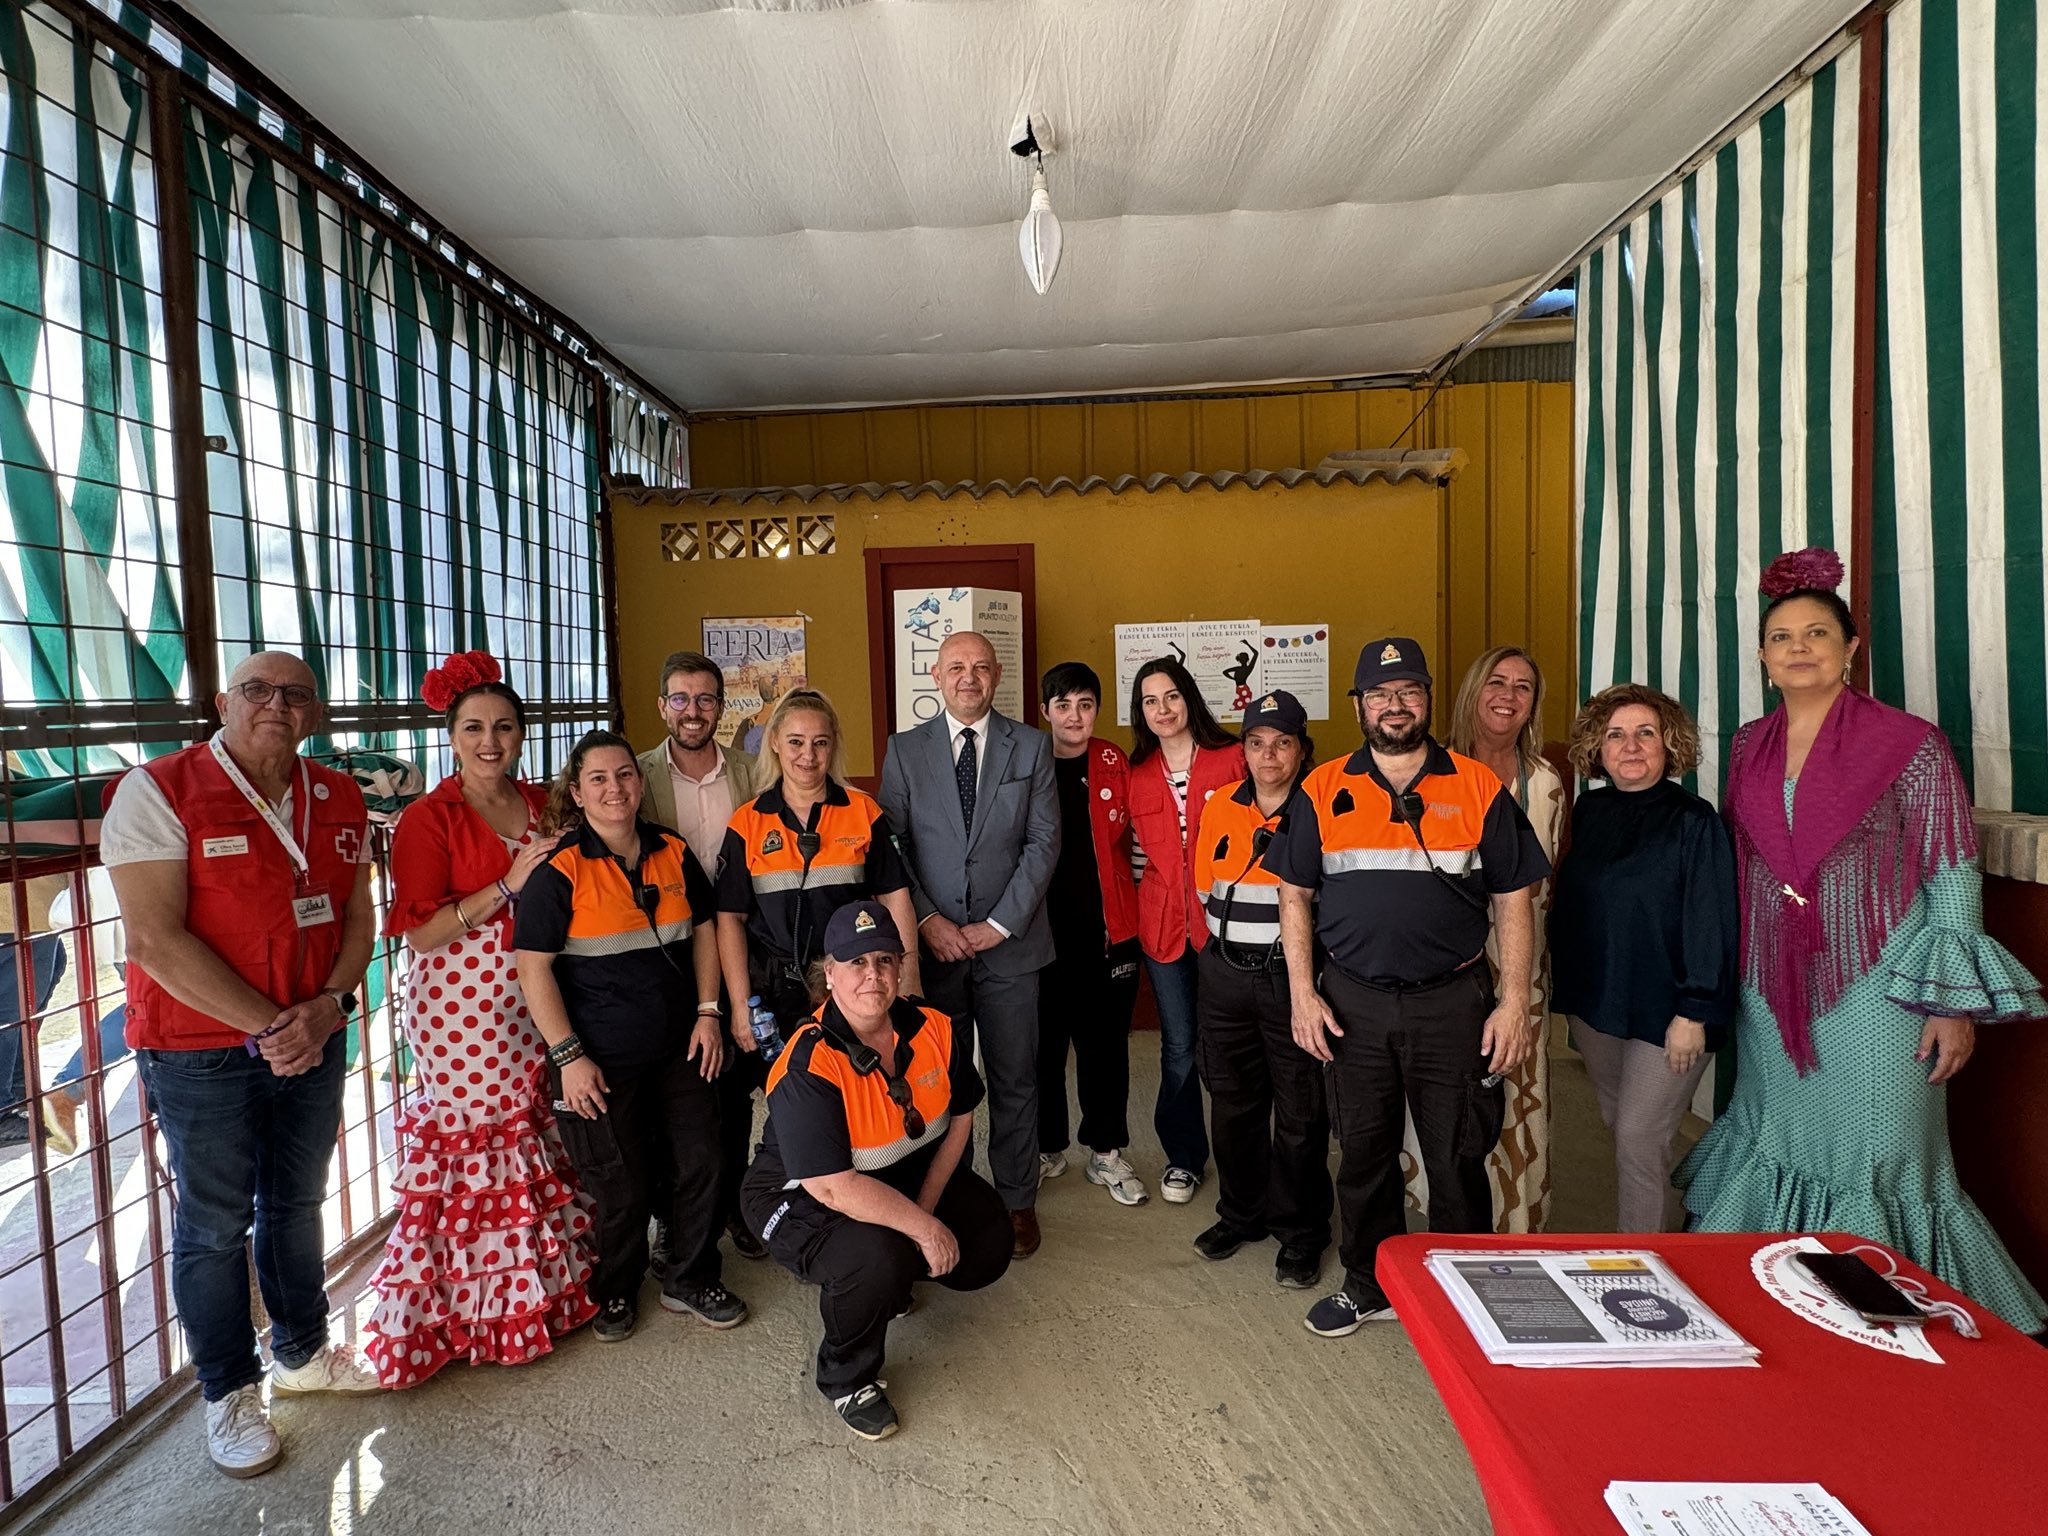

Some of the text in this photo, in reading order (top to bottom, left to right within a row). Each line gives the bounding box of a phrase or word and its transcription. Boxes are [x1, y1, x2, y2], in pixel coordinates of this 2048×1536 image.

[704, 629, 793, 662] FERIA
[911, 620, 940, 726] OLETA
[1618, 1298, 1660, 1309] UNIDAS
[1774, 1286, 1795, 1302] fue
[1794, 1302, 1843, 1331] nunca
[1848, 1330, 1906, 1352] viajar
[1793, 1493, 1832, 1530] DESDE
